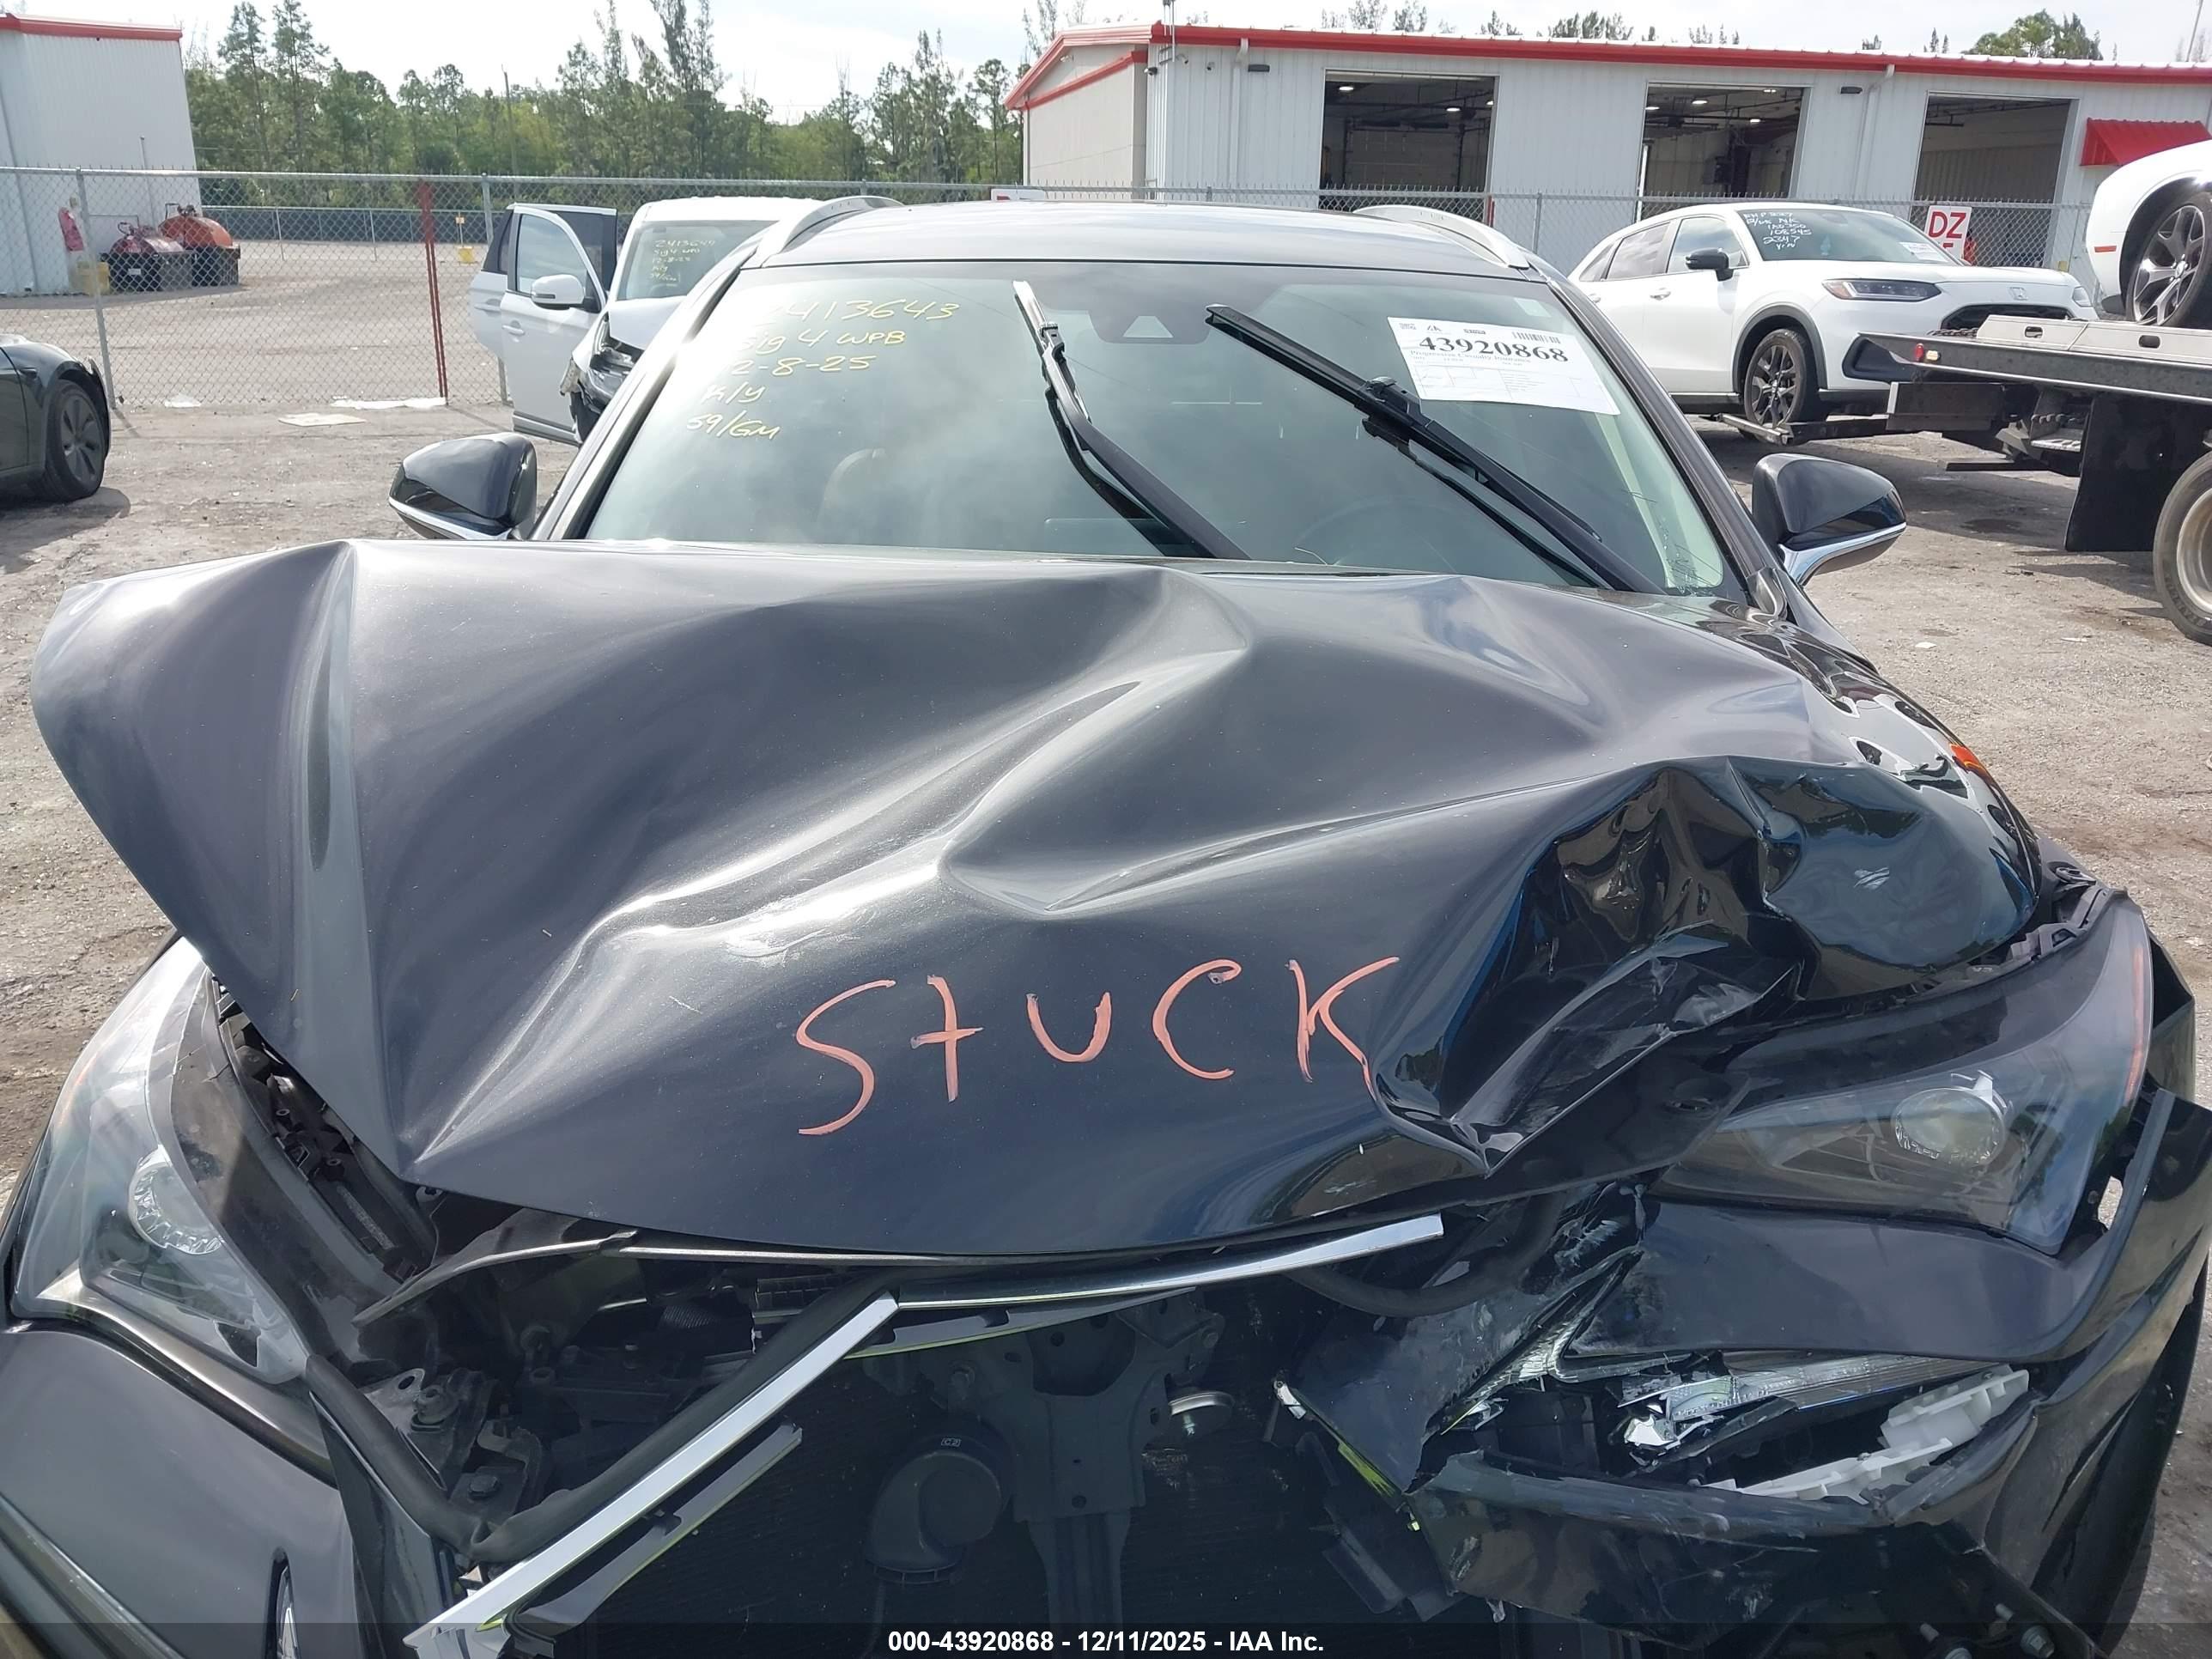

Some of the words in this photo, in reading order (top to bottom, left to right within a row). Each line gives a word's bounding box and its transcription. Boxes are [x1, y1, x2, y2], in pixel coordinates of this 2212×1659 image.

[1928, 211, 1966, 239] DZ
[797, 328, 829, 348] 4
[836, 330, 907, 346] WPB
[1419, 336, 1569, 362] 43920868
[724, 355, 877, 377] 2-8-25
